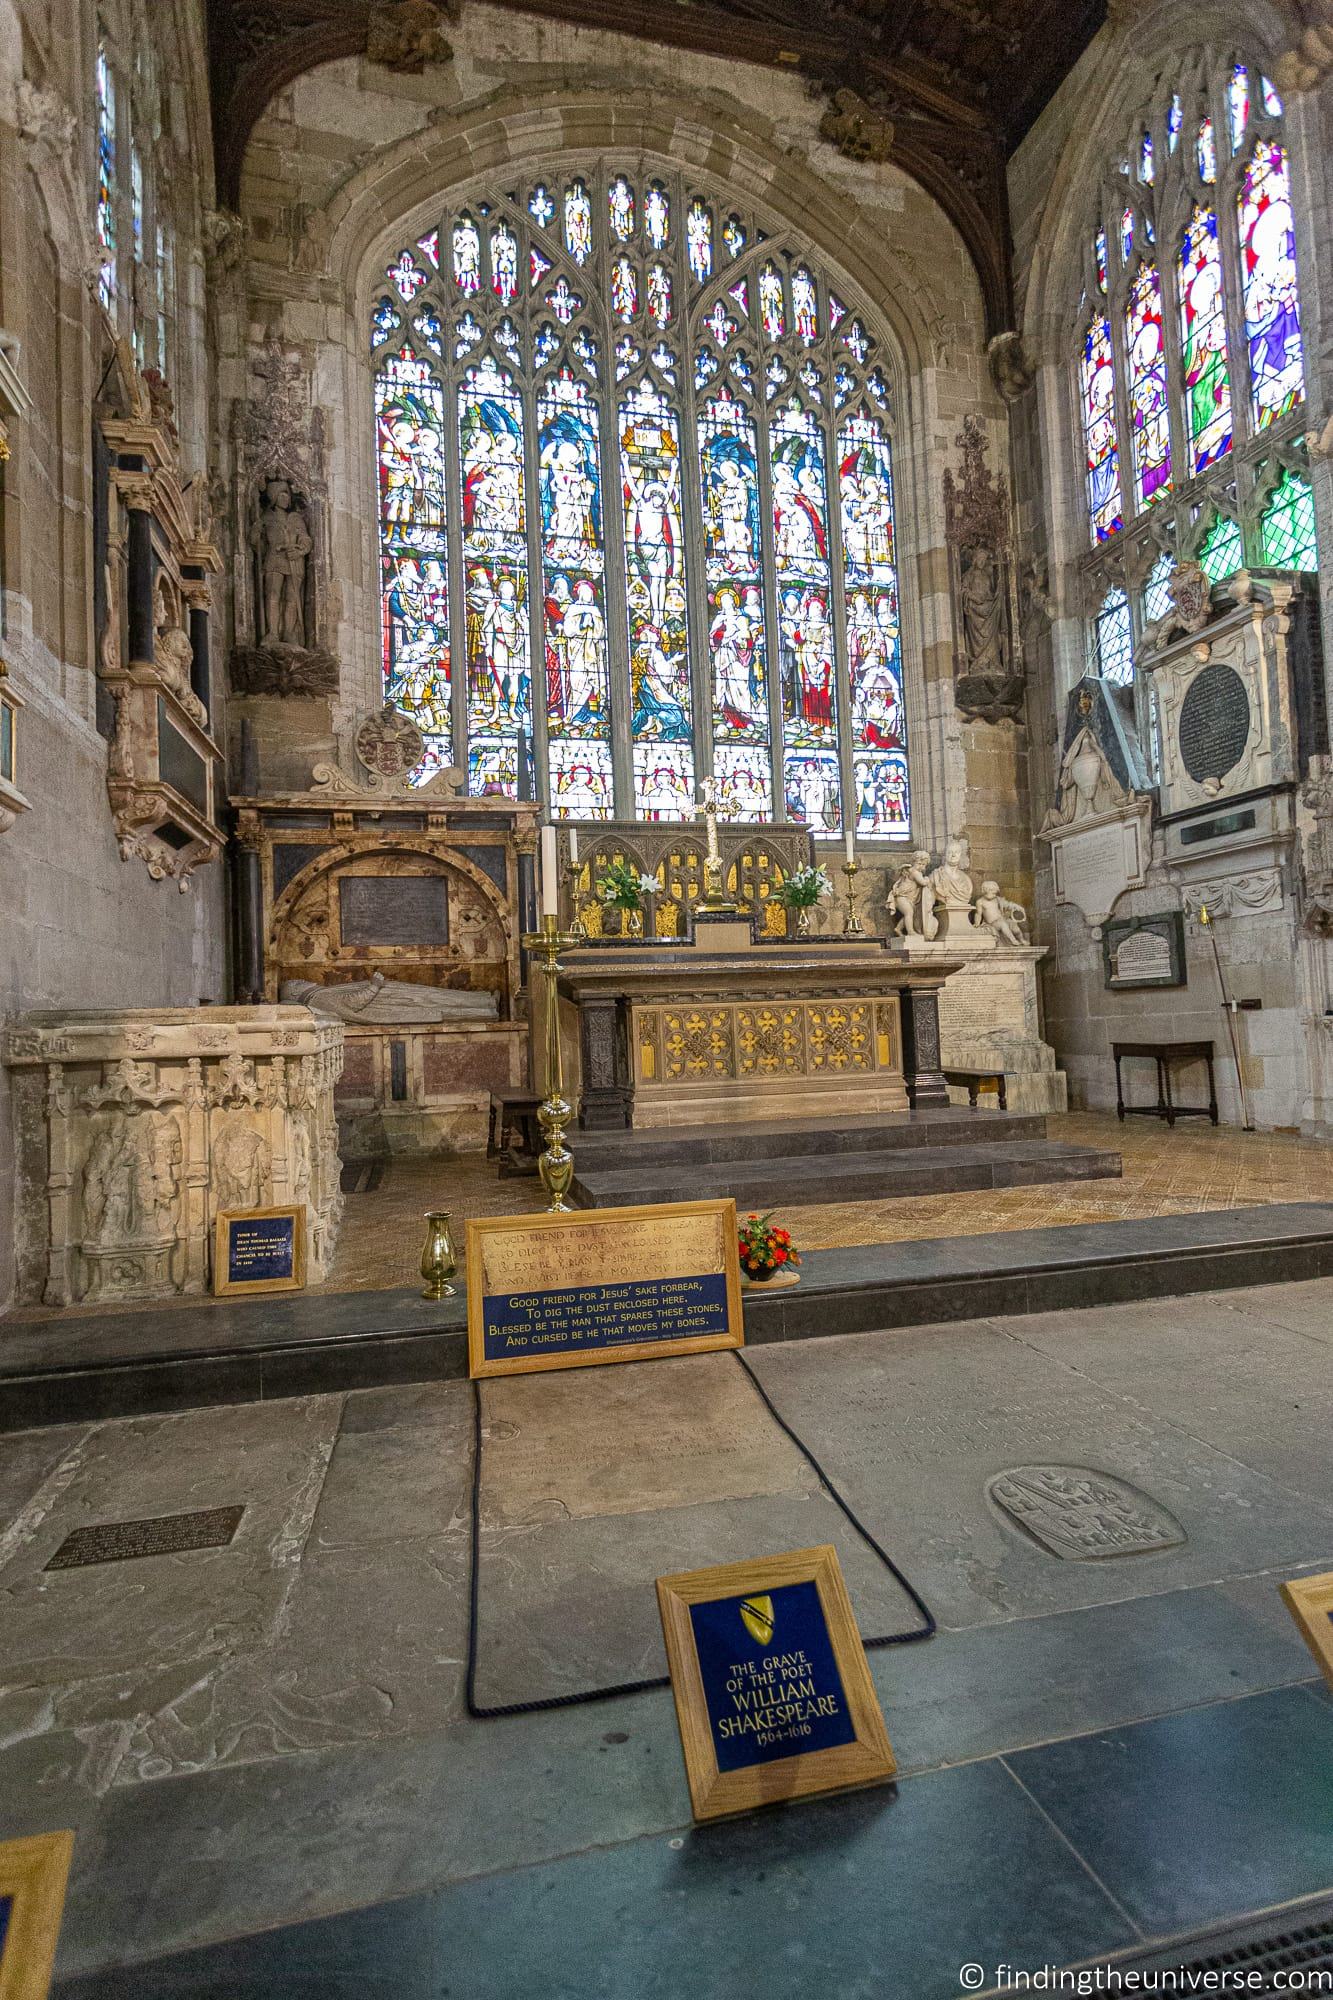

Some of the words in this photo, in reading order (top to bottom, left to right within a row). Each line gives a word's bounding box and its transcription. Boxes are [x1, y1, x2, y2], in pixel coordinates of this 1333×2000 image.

[509, 1298, 539, 1308] GOOD
[543, 1294, 576, 1305] FRIEND
[580, 1292, 596, 1301] FOR
[635, 1286, 658, 1296] SAKE
[661, 1282, 703, 1293] FORBEAR,
[526, 1308, 541, 1319] TO
[545, 1308, 562, 1317] DIG
[566, 1306, 582, 1315] THE
[586, 1303, 610, 1313] DUST
[614, 1299, 659, 1310] ENCLOSED
[662, 1296, 688, 1305] HERE.
[489, 1324, 532, 1336] BLESSED
[536, 1322, 547, 1331] BE
[550, 1320, 568, 1329] THE
[572, 1318, 591, 1327] MAN
[595, 1314, 616, 1324] THAT
[620, 1311, 654, 1322] SPARES
[657, 1308, 684, 1318] THESE
[688, 1304, 724, 1315] STONES,
[506, 1336, 528, 1347] AND
[532, 1332, 568, 1344] CURSED
[572, 1331, 583, 1340] BE
[587, 1328, 598, 1338] HE
[602, 1326, 624, 1336] THAT
[628, 1322, 658, 1333] MOVES
[662, 1320, 674, 1330] MY
[677, 1317, 709, 1328] BONES.
[726, 1678, 744, 1692] OF
[749, 1671, 776, 1687] THE
[781, 1662, 814, 1680] POET
[730, 1661, 756, 1677] THE
[762, 1650, 807, 1671] GRAVE
[732, 1678, 816, 1712] WILLIAM
[718, 1694, 838, 1738] SHAKESPEARE
[756, 1722, 812, 1748] 1564-1616
